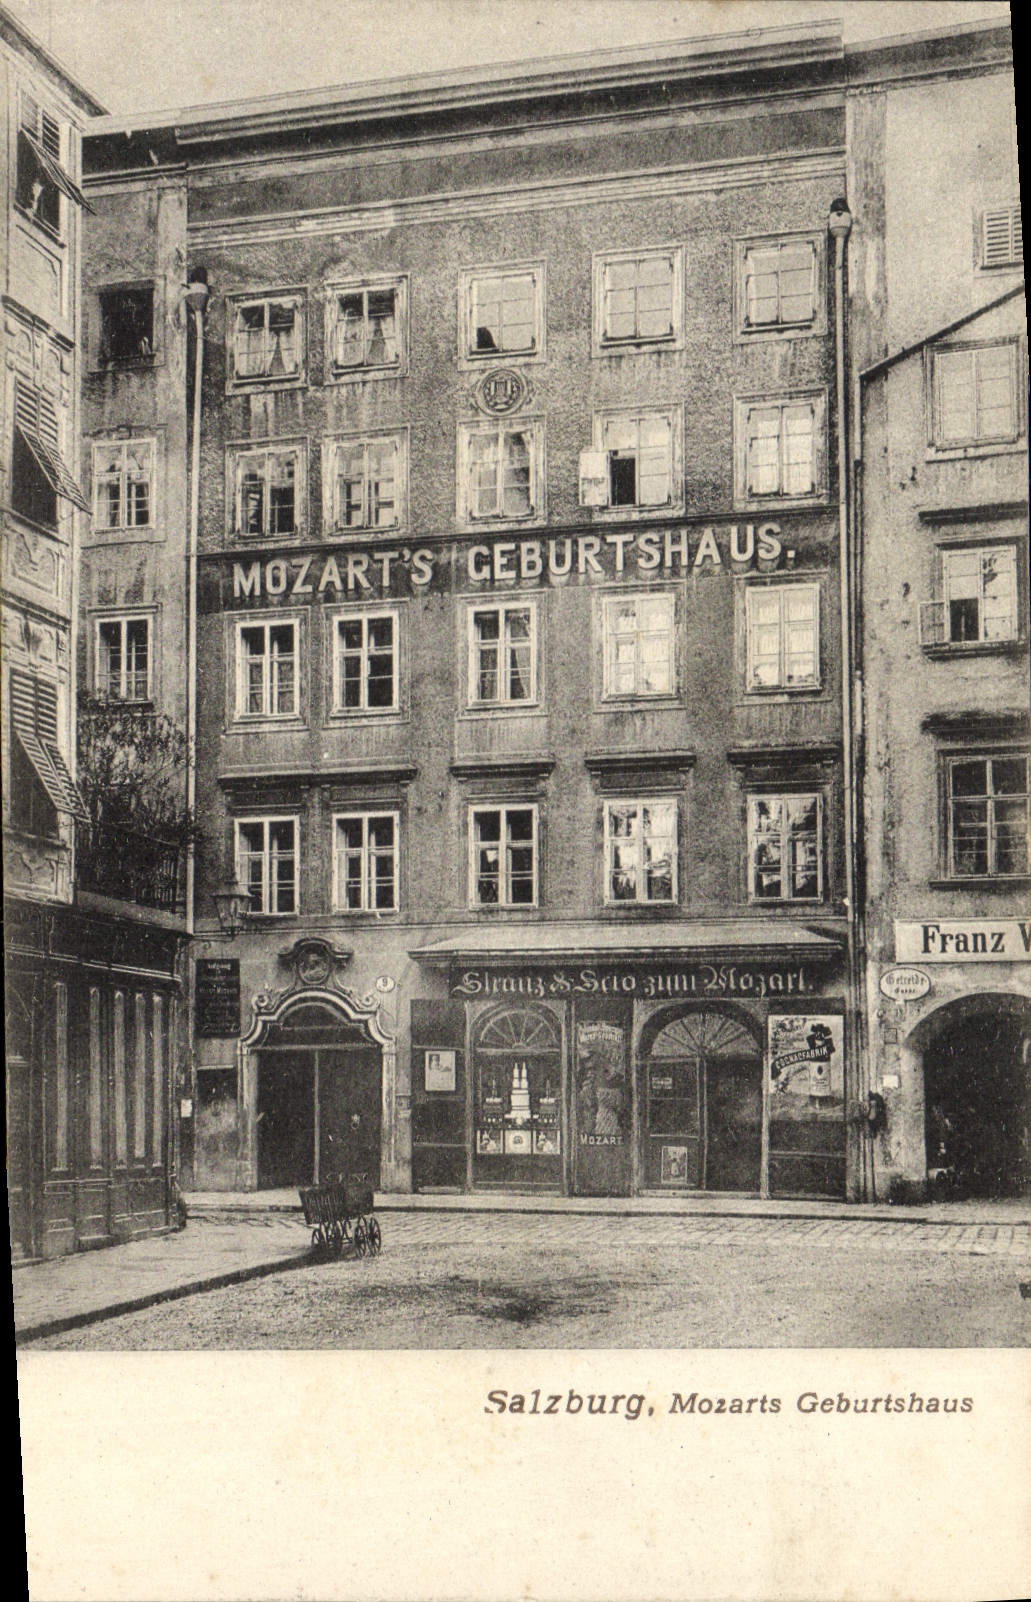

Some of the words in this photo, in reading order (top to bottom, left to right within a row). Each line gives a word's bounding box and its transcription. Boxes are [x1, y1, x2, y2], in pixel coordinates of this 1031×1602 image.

[232, 549, 434, 598] MOZART'S
[467, 522, 796, 581] GEBURTSHAUS.
[921, 924, 1006, 954] Franz
[644, 974, 697, 997] zum
[580, 1132, 624, 1146] MOZART
